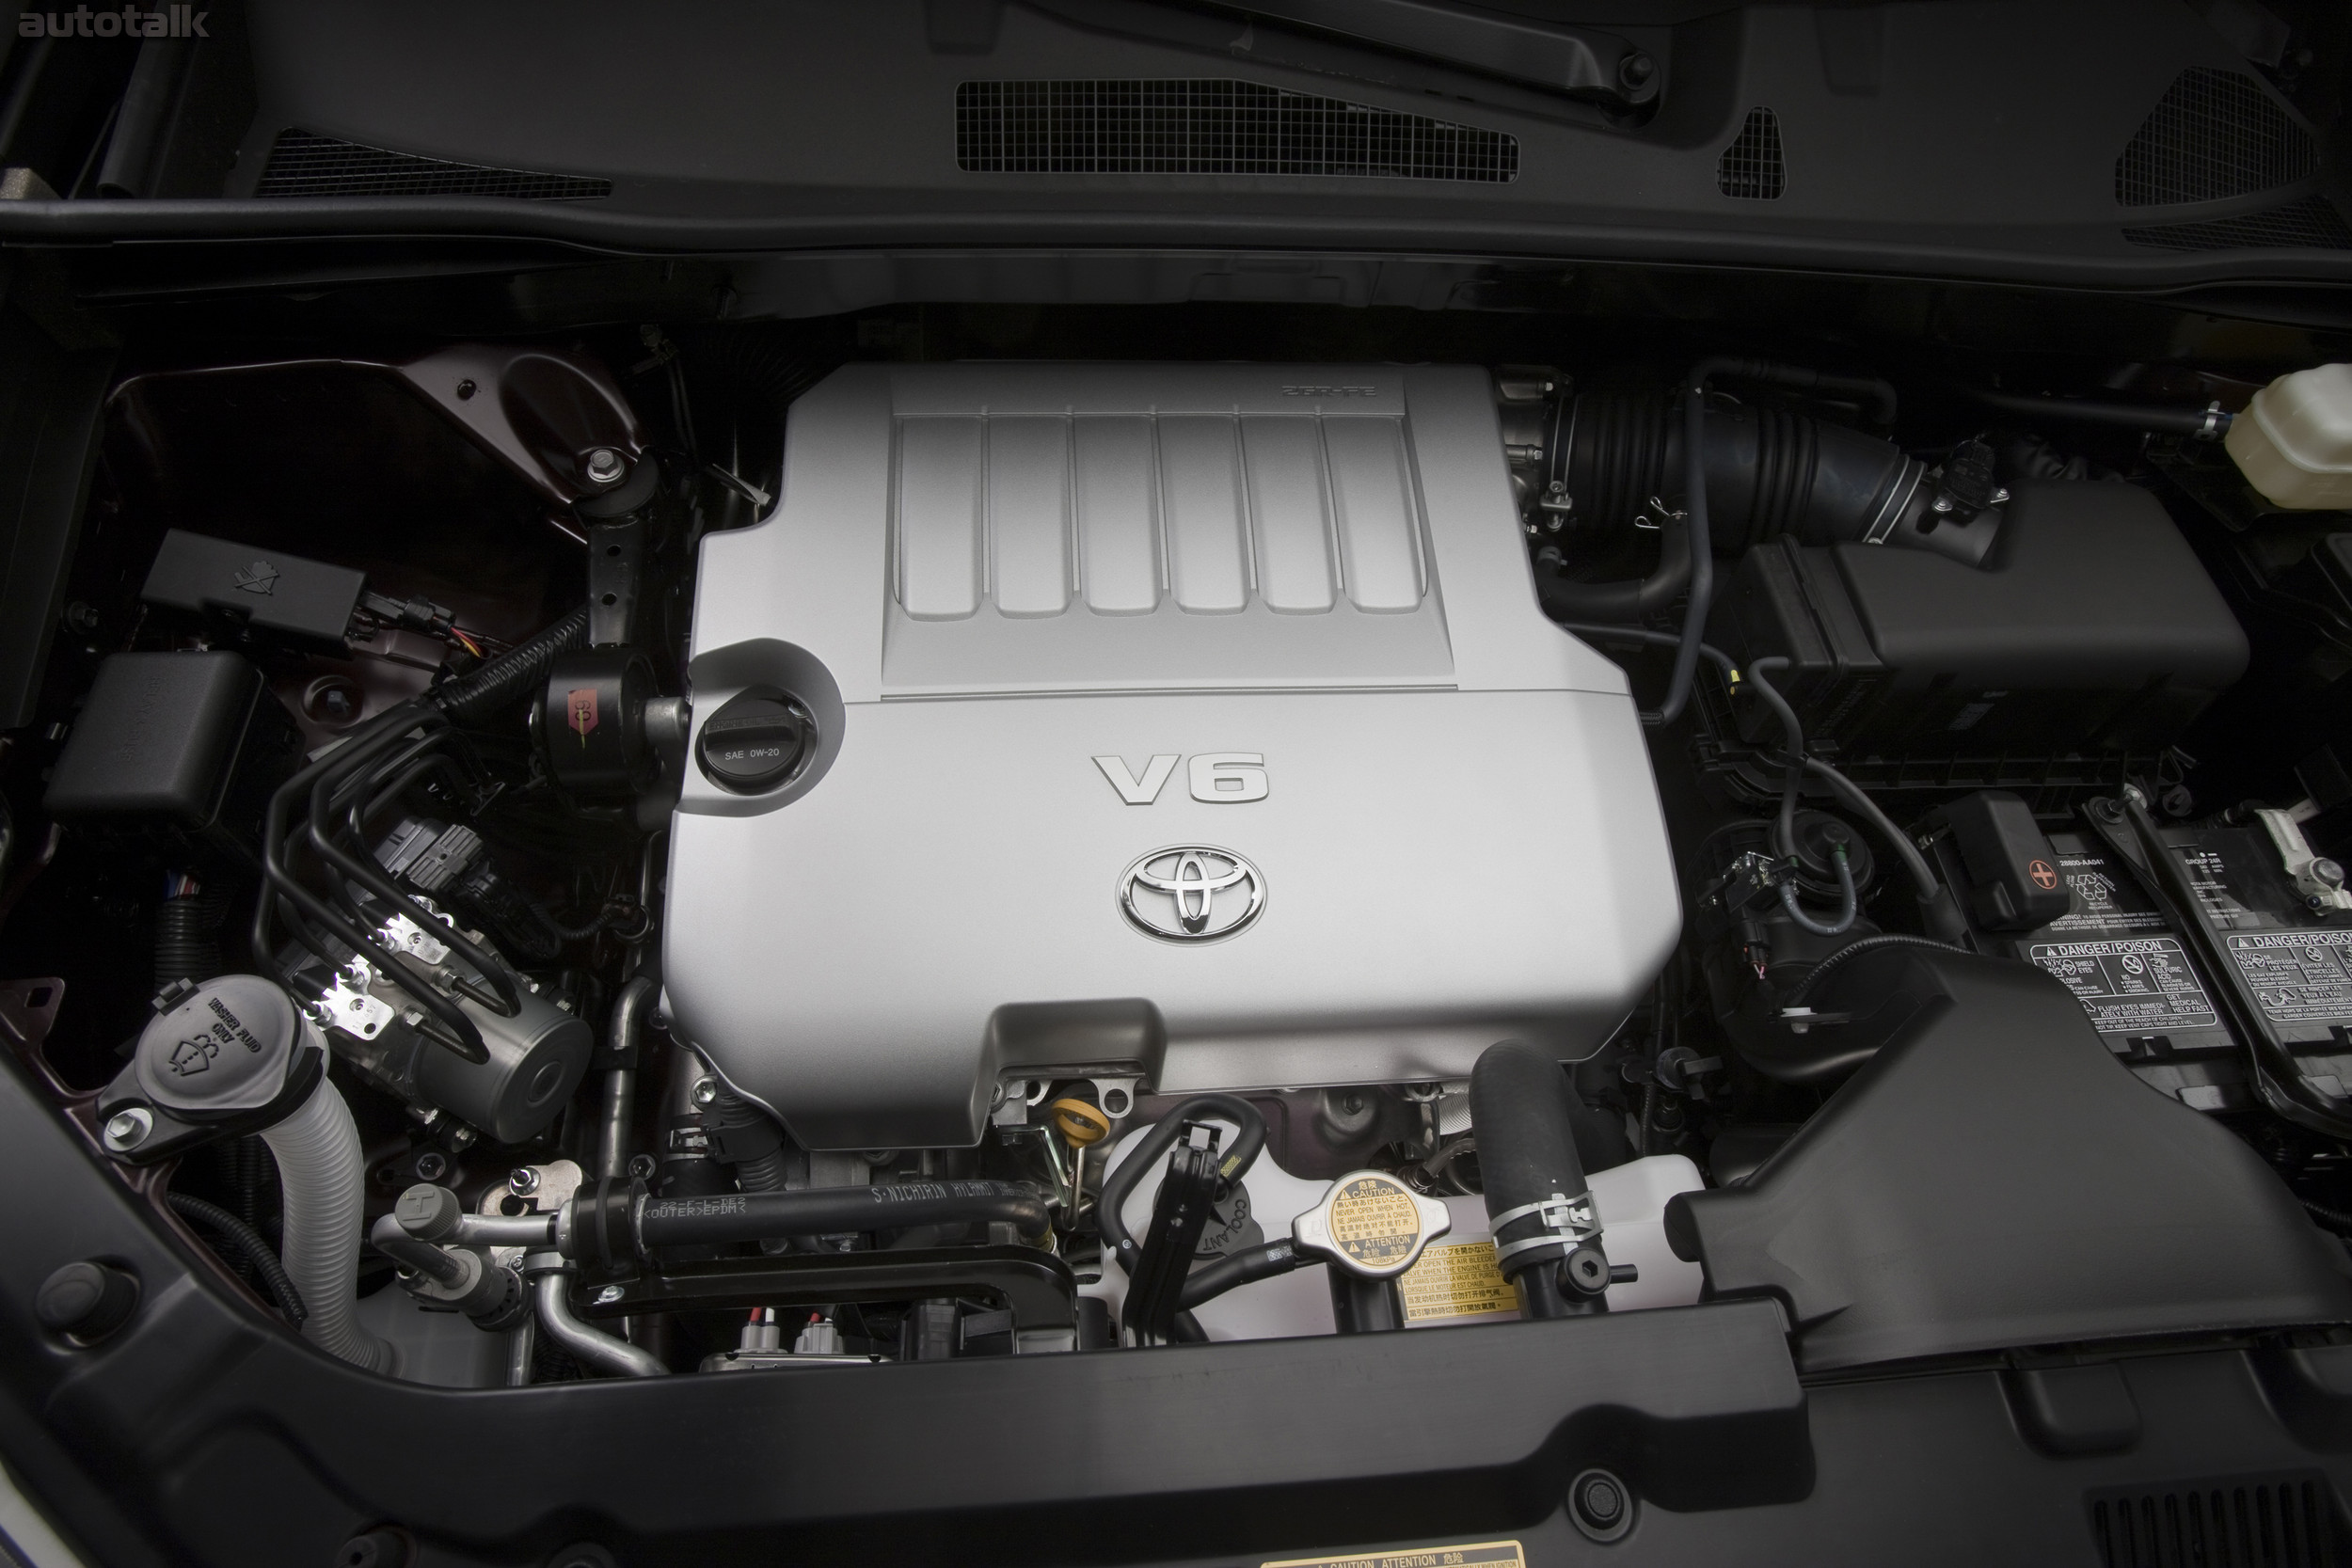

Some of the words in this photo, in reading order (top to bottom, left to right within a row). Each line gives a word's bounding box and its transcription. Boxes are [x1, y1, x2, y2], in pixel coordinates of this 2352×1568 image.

[1281, 386, 1376, 396] 2GR-FE
[724, 751, 744, 761] SAE
[750, 748, 780, 758] 0W-20
[1091, 753, 1269, 806] V6
[2058, 941, 2163, 956] DANGER/POISON
[2153, 966, 2183, 974] SULFURIC
[208, 998, 241, 1031] WASHER
[236, 1028, 262, 1053] FLUID
[212, 1022, 235, 1044] ONLY
[1352, 1187, 1395, 1199] CAUTION
[1336, 1209, 1355, 1217] NEVER
[1346, 1214, 1365, 1223] JAMAIS
[1366, 1212, 1386, 1221] OUVRIR
[1202, 1199, 1247, 1251] COOLANT
[1365, 1236, 1410, 1248] ATTENTION
[1372, 1256, 1396, 1265] 108kPa
[1457, 1264, 1482, 1273] ENGINE
[1382, 1555, 1437, 1568] ATTENTION
